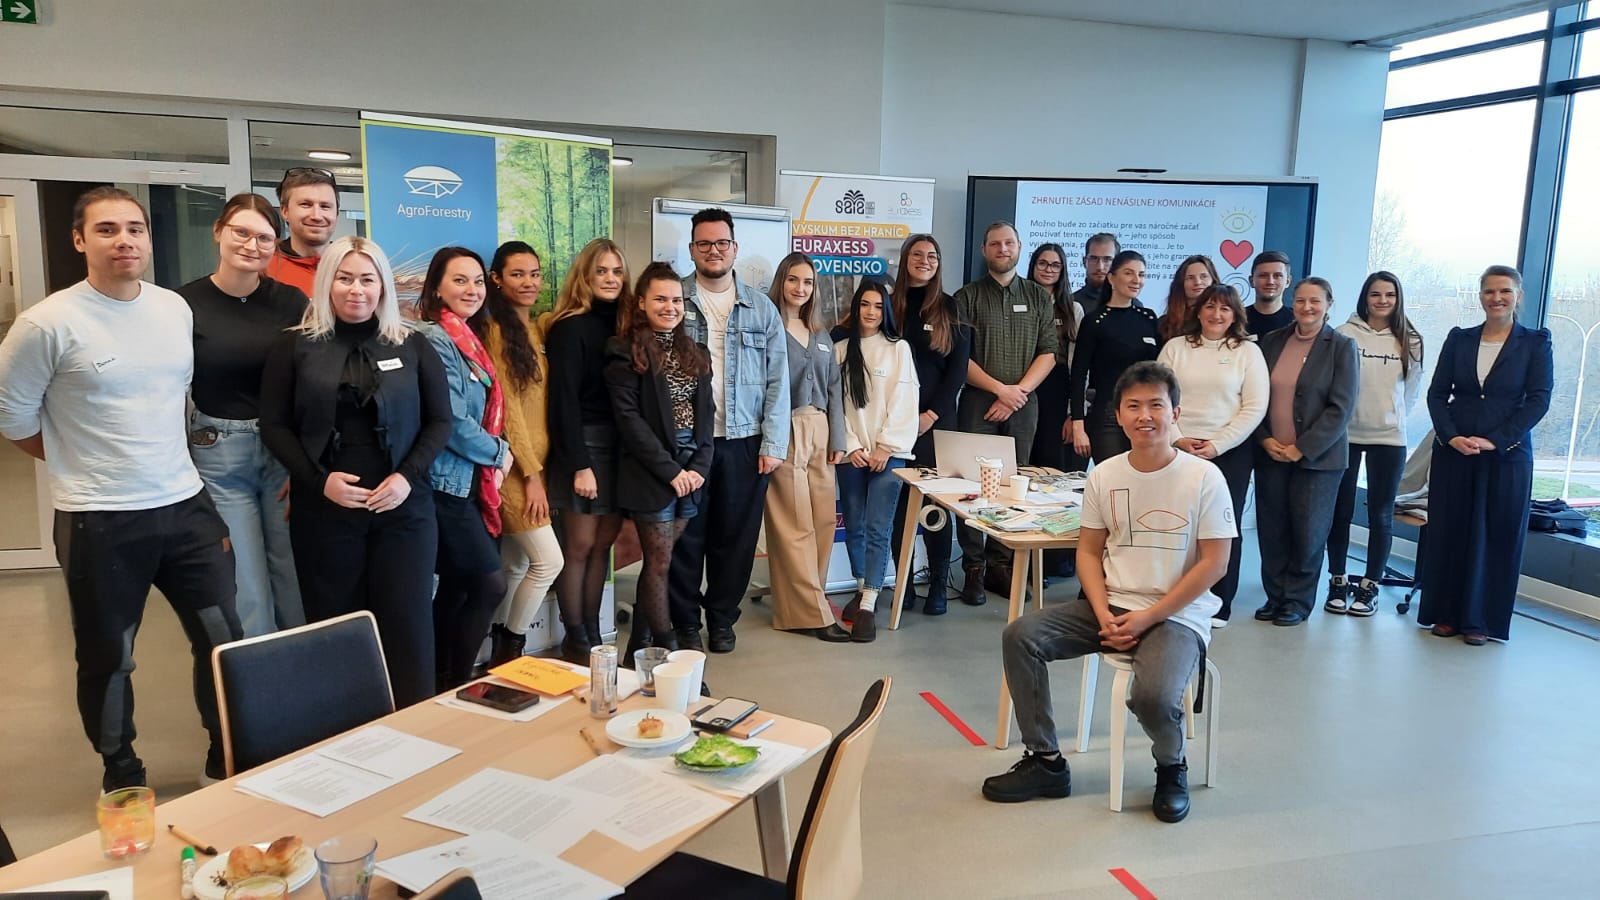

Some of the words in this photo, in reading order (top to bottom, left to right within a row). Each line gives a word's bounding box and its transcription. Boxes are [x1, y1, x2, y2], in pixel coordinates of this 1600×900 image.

[1031, 196, 1074, 205] ZHRNUTIE
[1075, 196, 1103, 206] ZÁSAD
[1105, 196, 1155, 207] NENÁSILNEJ
[1157, 198, 1216, 208] KOMUNIKÁCIE
[397, 203, 472, 221] AgroForestry
[793, 223, 838, 235] VÝSKUM
[840, 226, 862, 236] BEZ
[863, 226, 904, 237] HRANÍC
[1030, 219, 1056, 228] Možno
[1057, 219, 1077, 228] bude
[1131, 232, 1148, 240] jeho
[793, 239, 869, 254] EURAXESS
[1152, 253, 1170, 261] jeho
[814, 259, 882, 274] OVENSKO
[1358, 348, 1401, 365] hampio
